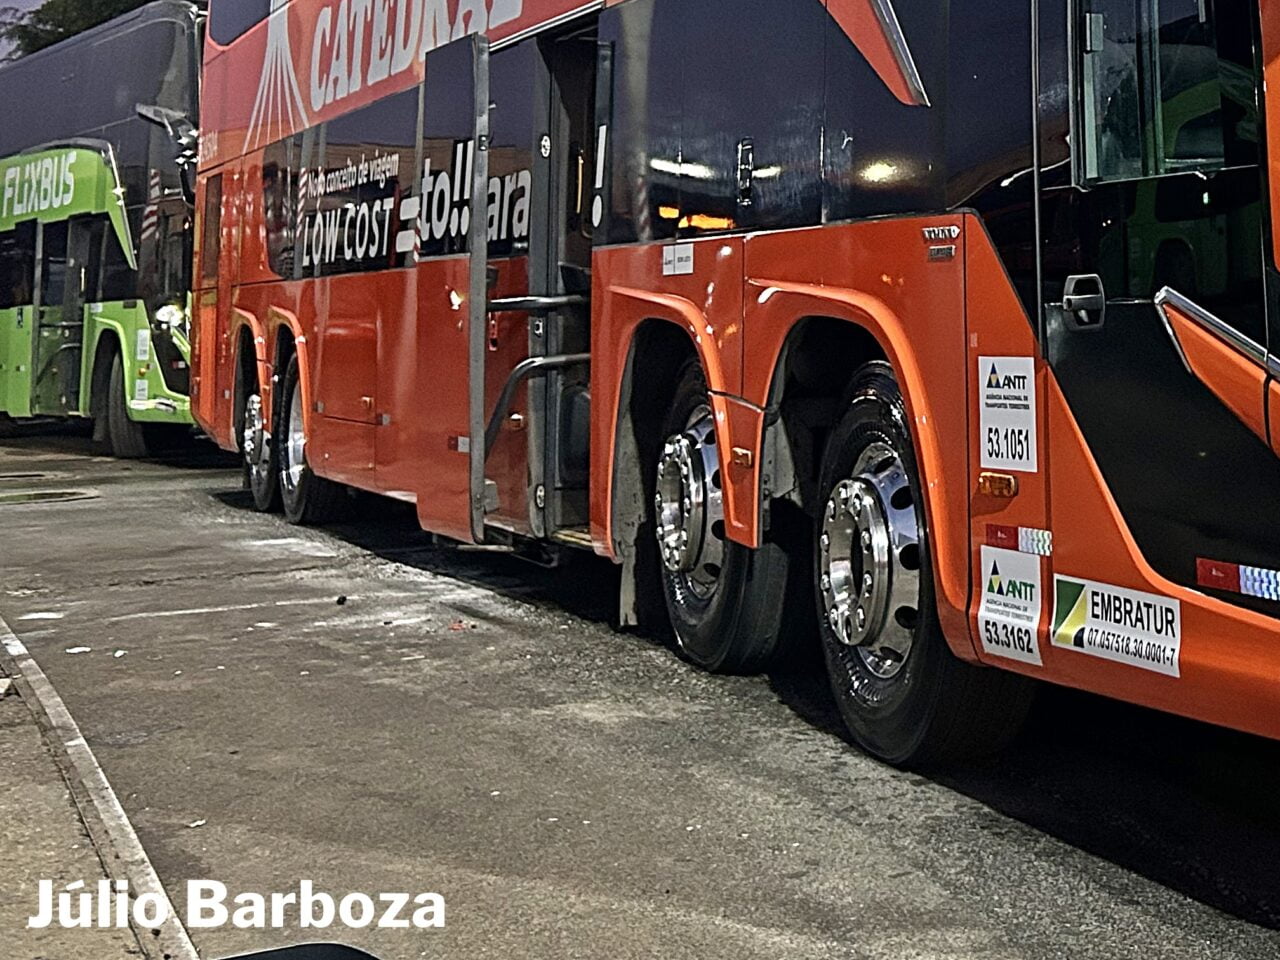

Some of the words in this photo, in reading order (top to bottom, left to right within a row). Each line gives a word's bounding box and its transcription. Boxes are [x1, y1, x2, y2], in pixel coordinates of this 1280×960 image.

[302, 208, 341, 266] LOW
[344, 197, 394, 260] COST
[1001, 375, 1028, 390] ANTT
[987, 427, 1030, 461] 53.1051
[1005, 579, 1035, 602] ANTT
[1091, 591, 1175, 637] EMBRATUR
[985, 620, 1033, 653] 53.3162
